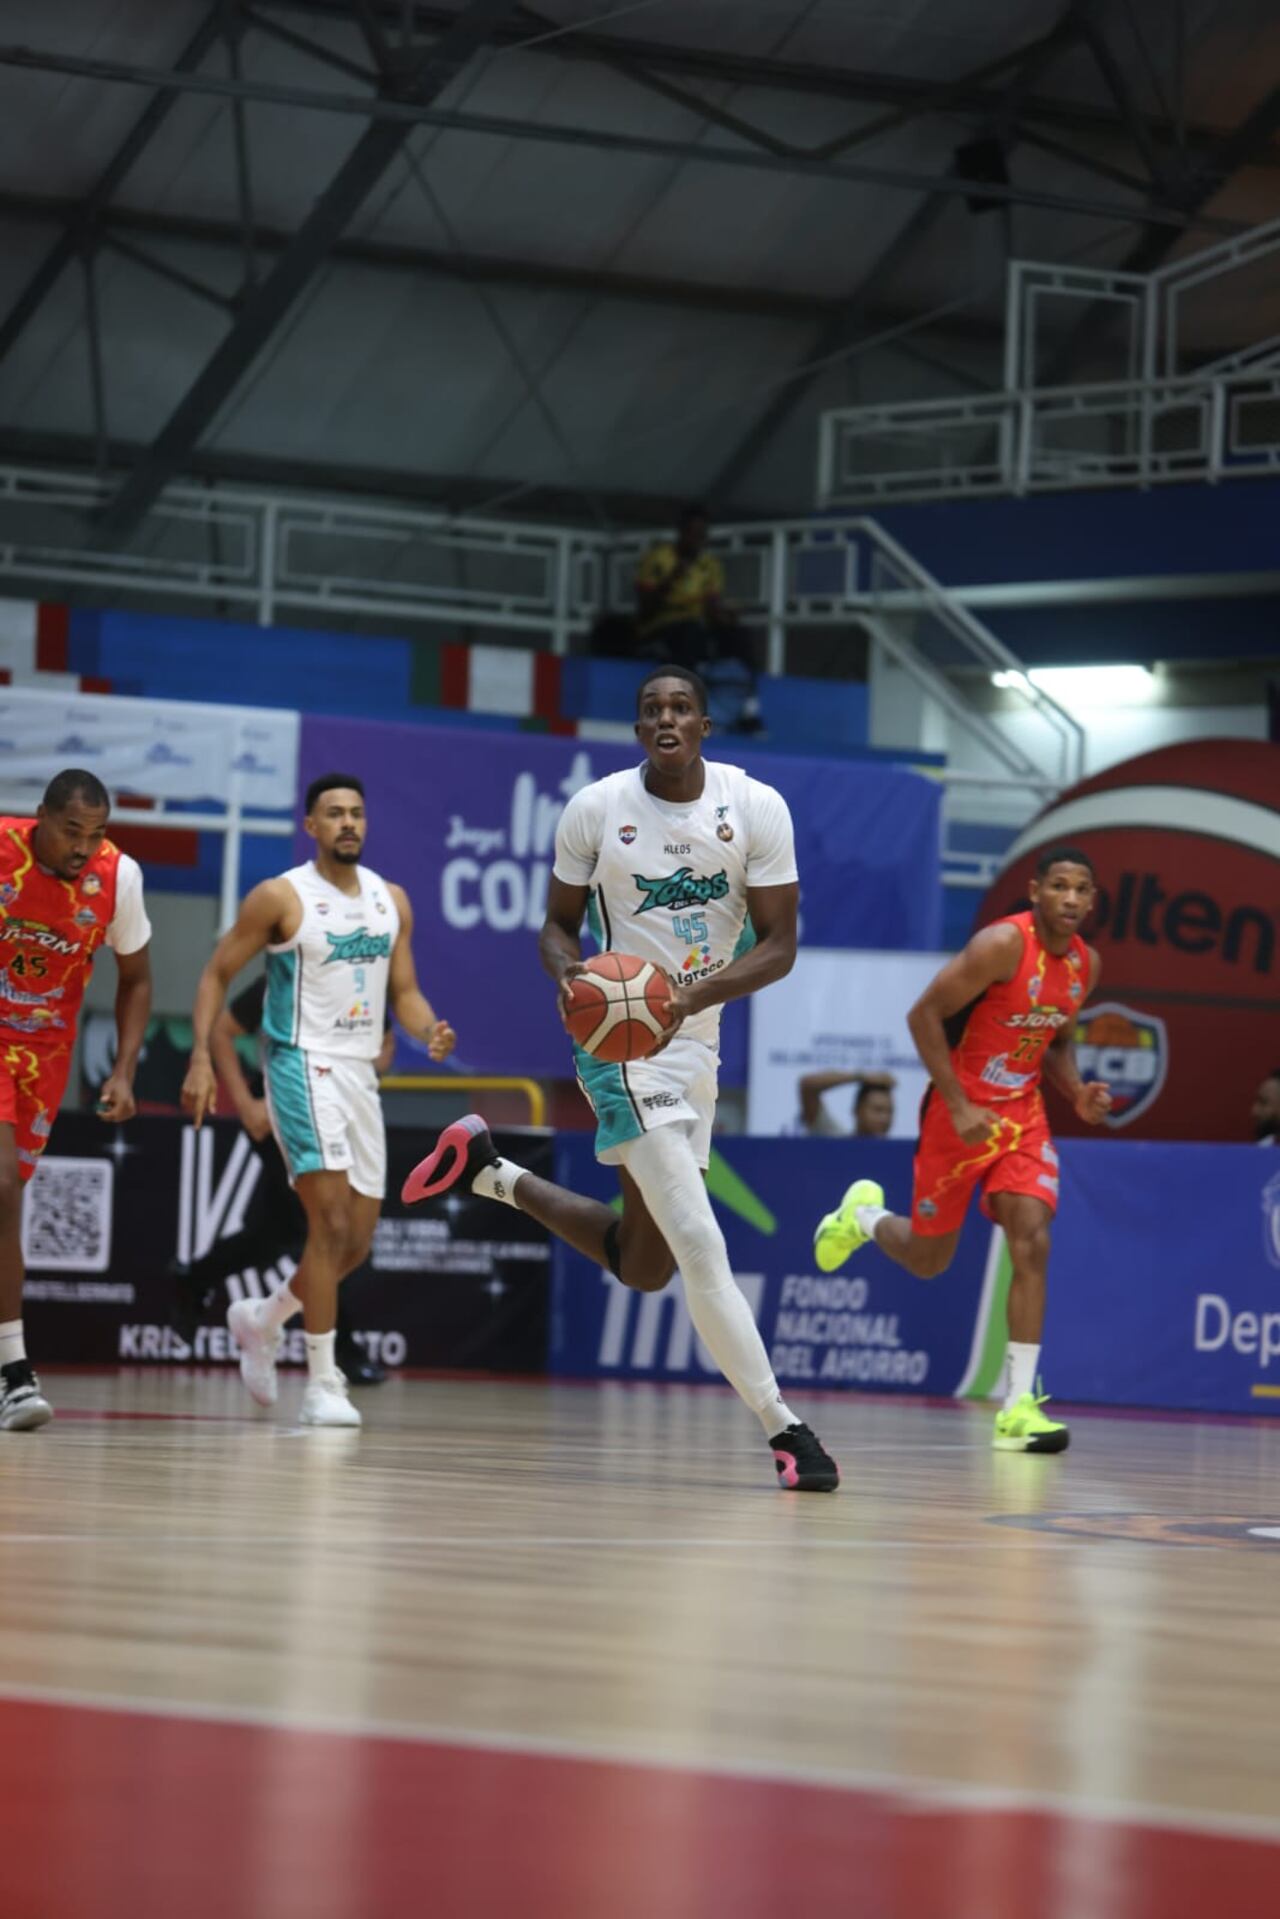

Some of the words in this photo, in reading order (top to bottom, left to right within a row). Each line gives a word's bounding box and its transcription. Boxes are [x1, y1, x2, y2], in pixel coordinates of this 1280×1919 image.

[442, 858, 549, 932] COL
[671, 911, 709, 945] 45
[11, 953, 49, 978] 45
[1012, 1036, 1043, 1060] 77
[780, 1275, 869, 1311] FONDO
[775, 1311, 902, 1347] NACIONAL
[1195, 1293, 1280, 1368] Dep
[770, 1345, 815, 1378] DEL
[819, 1348, 930, 1384] AHORRO
